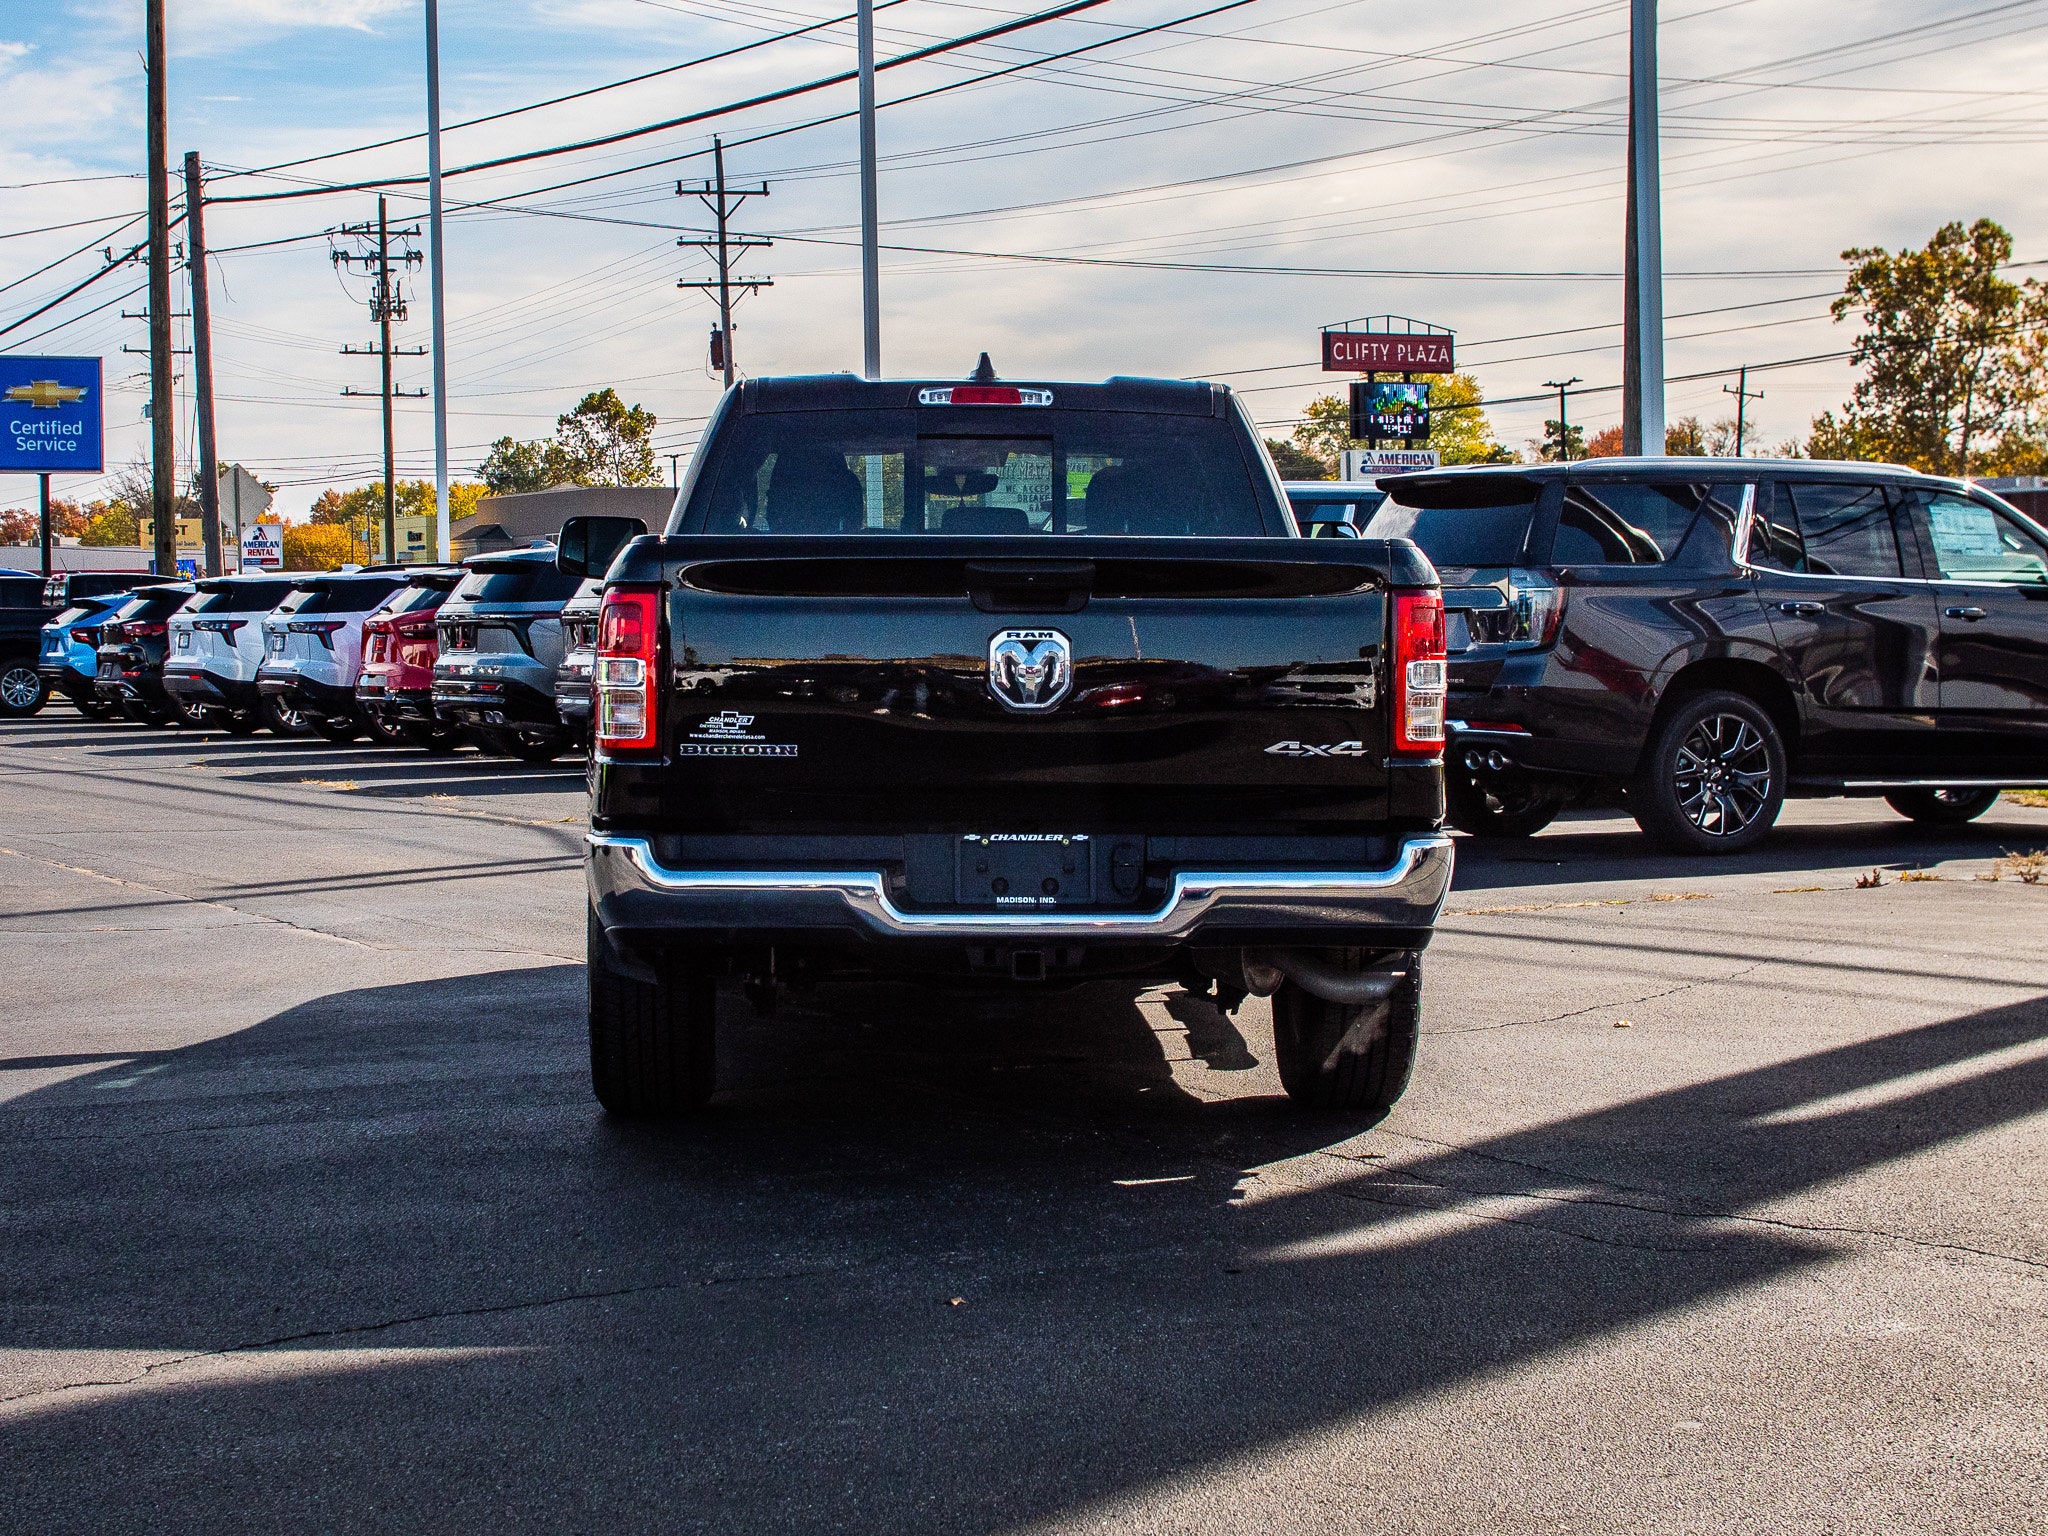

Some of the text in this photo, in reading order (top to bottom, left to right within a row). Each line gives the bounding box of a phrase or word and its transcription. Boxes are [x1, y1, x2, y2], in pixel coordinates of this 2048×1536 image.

[1333, 342, 1449, 363] CLIFTY PLAZA
[10, 420, 82, 435] Certified
[16, 437, 77, 451] Service
[1378, 453, 1435, 465] AMERICAN
[1023, 484, 1050, 494] ACCEP
[680, 744, 798, 757] BIGHORN
[1039, 896, 1057, 904] IND.
